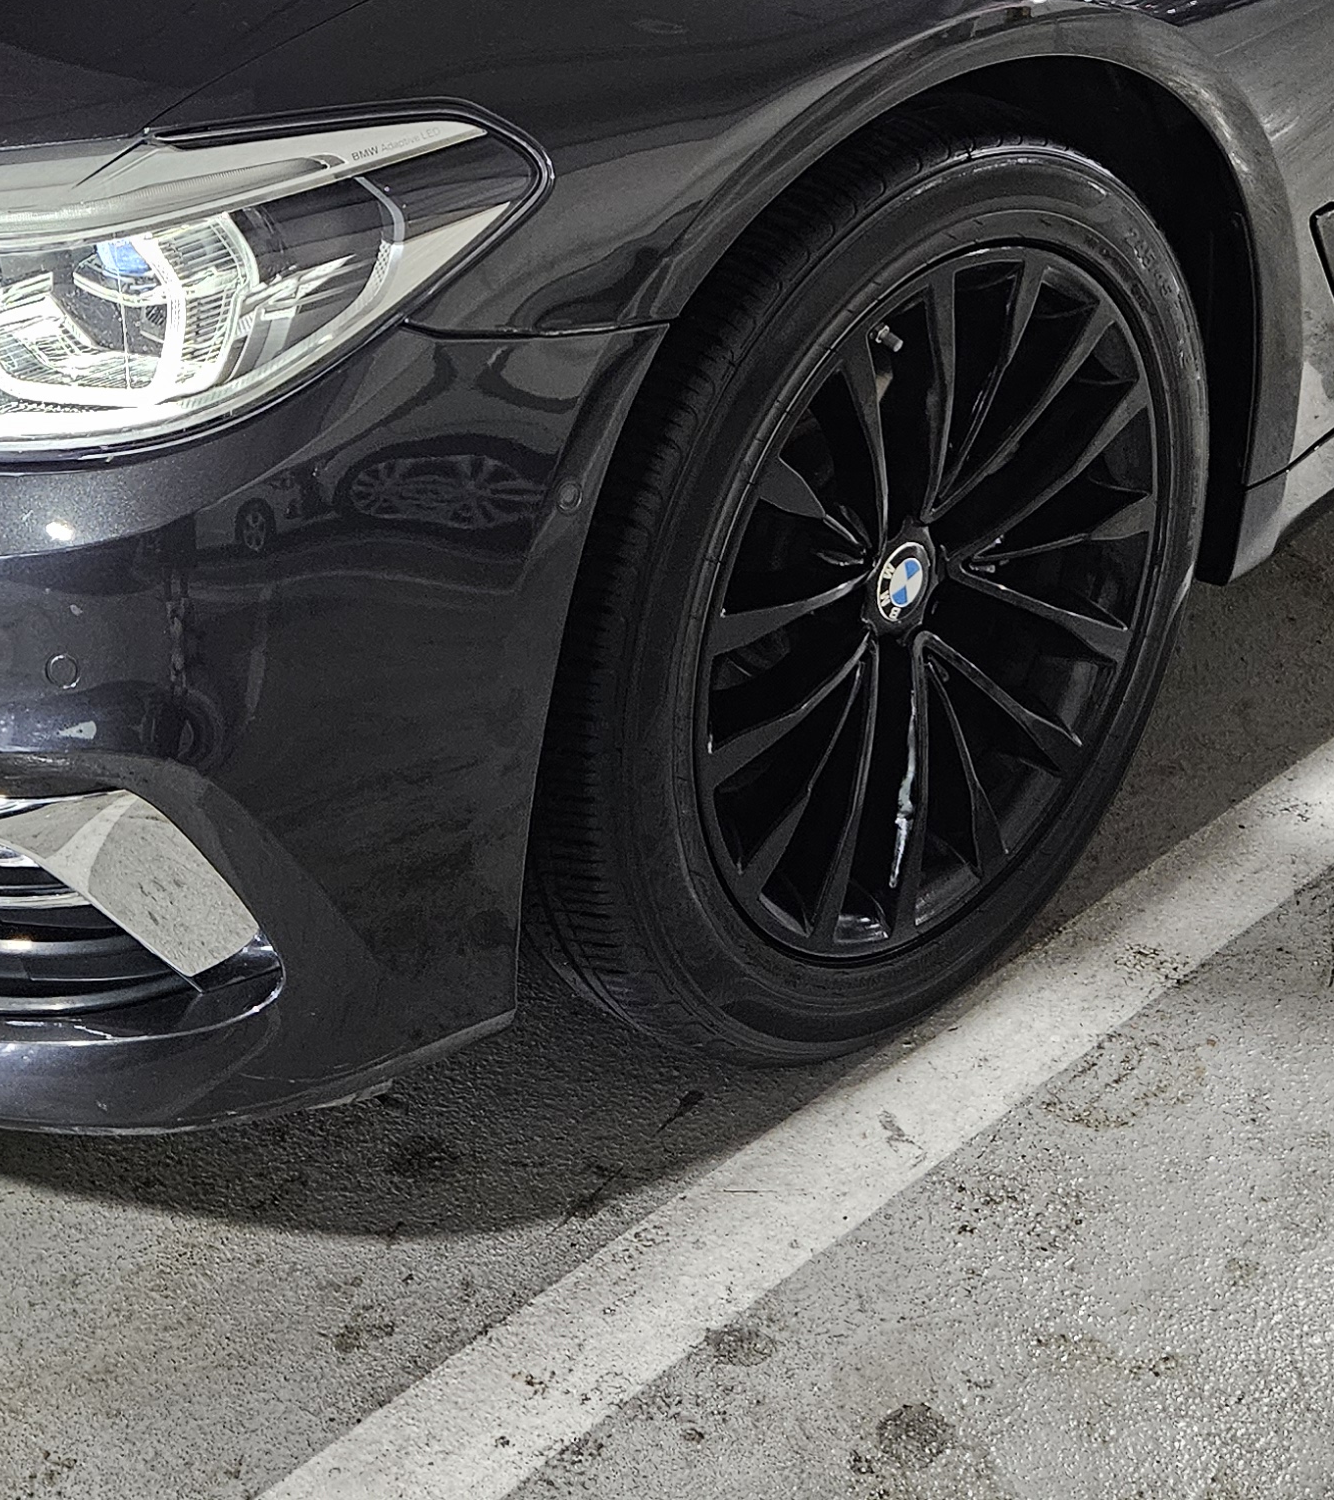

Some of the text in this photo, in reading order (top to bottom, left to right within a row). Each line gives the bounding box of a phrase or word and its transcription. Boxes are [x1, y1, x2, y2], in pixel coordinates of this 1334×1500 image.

[351, 126, 442, 161] BMW Adaptive LED
[879, 562, 902, 620] BMW
